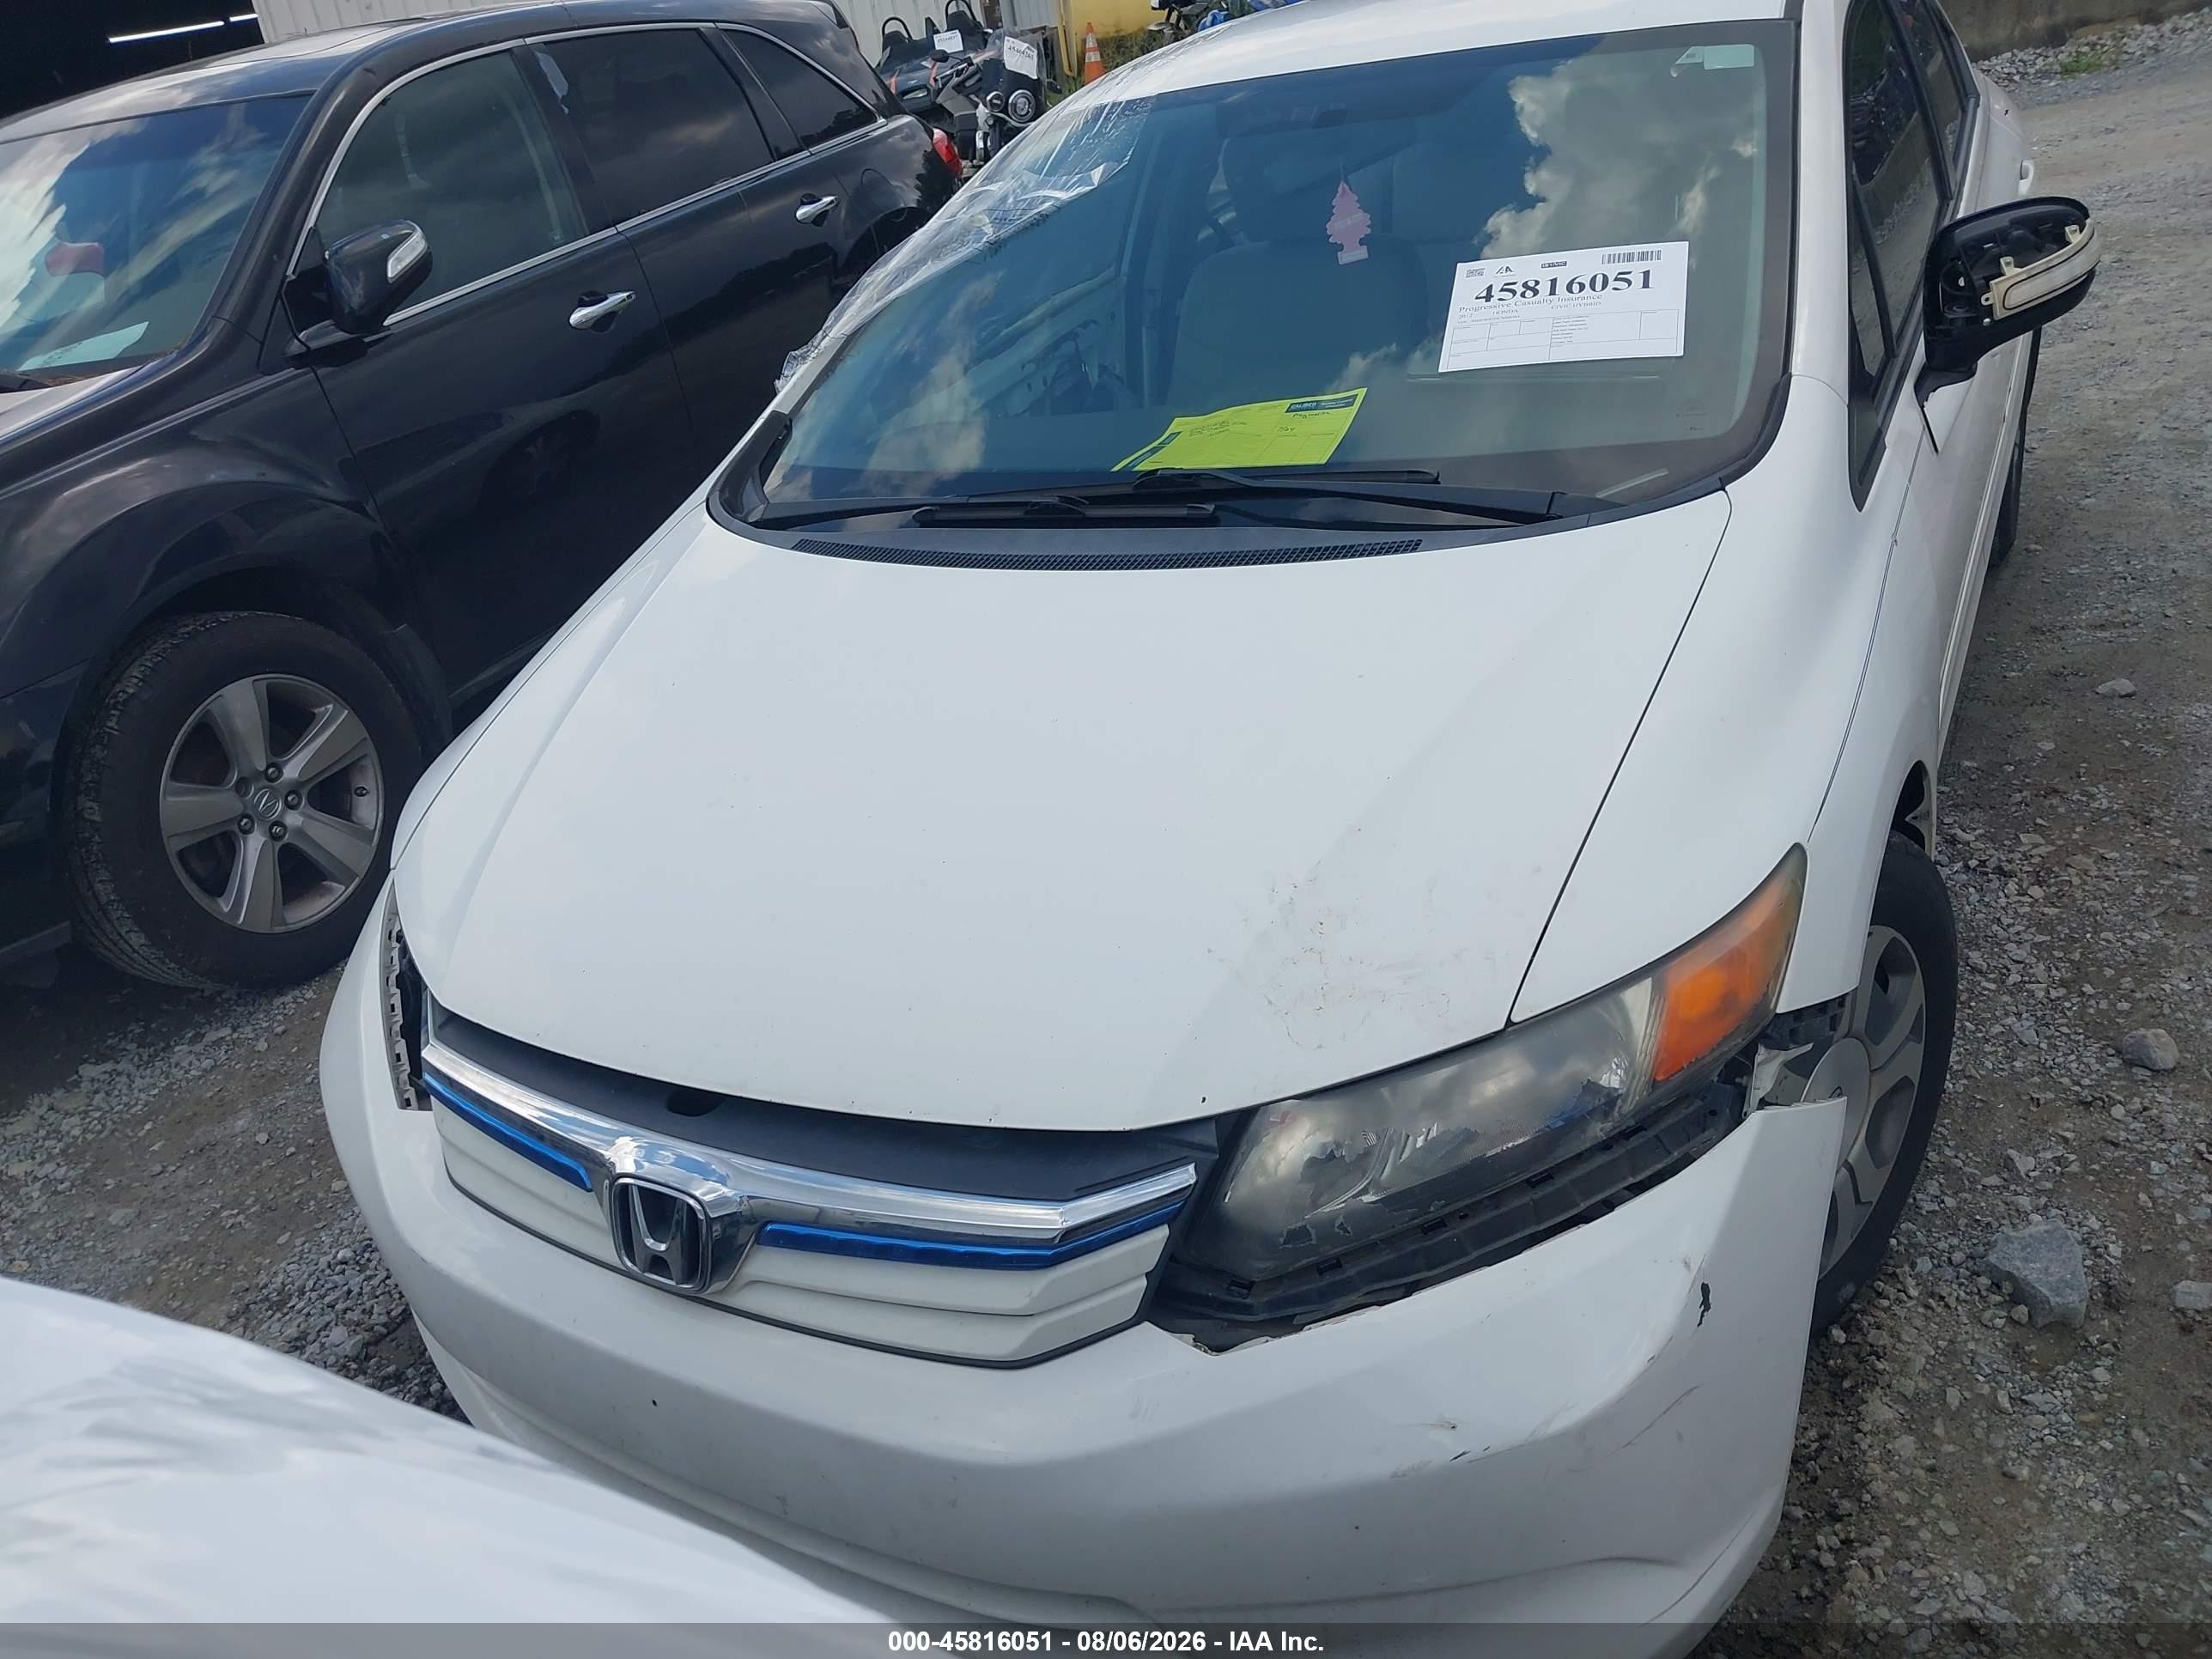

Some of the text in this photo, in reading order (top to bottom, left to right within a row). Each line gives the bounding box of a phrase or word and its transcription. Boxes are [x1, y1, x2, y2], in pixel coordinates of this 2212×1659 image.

[1474, 268, 1655, 303] 45816051
[1459, 294, 1603, 313] Progressive Casualty Insurance
